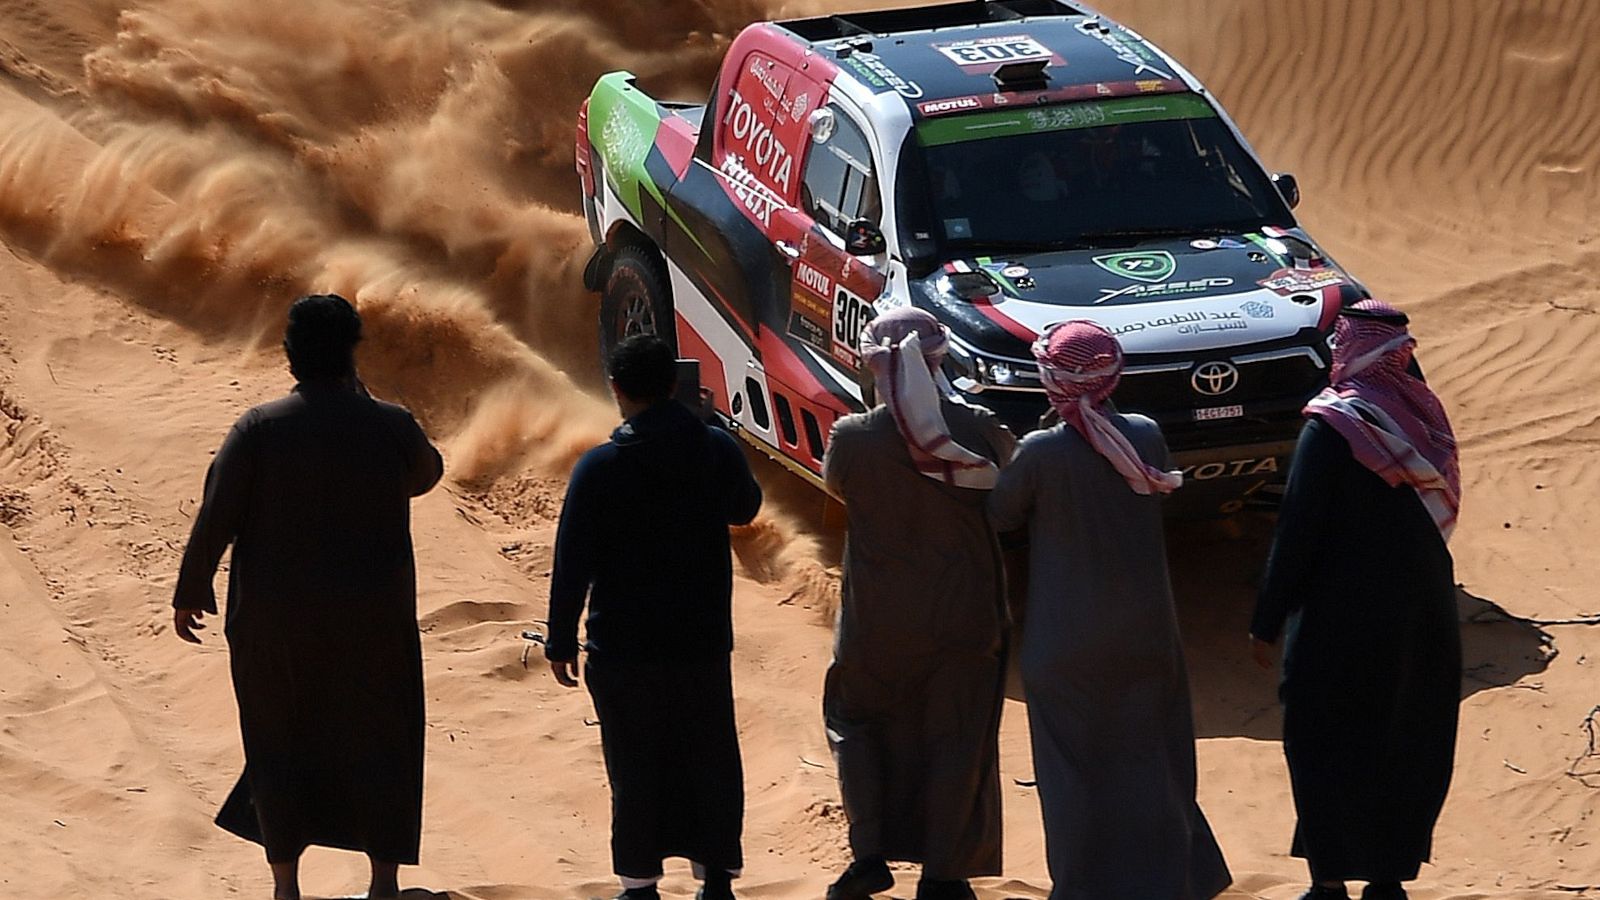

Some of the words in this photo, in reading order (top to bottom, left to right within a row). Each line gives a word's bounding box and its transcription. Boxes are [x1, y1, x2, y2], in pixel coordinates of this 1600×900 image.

[952, 42, 1039, 61] 303
[924, 98, 977, 113] MOTUL
[723, 88, 793, 194] TOYOTA
[797, 262, 830, 296] MOTUL
[1094, 277, 1234, 303] YAZEED
